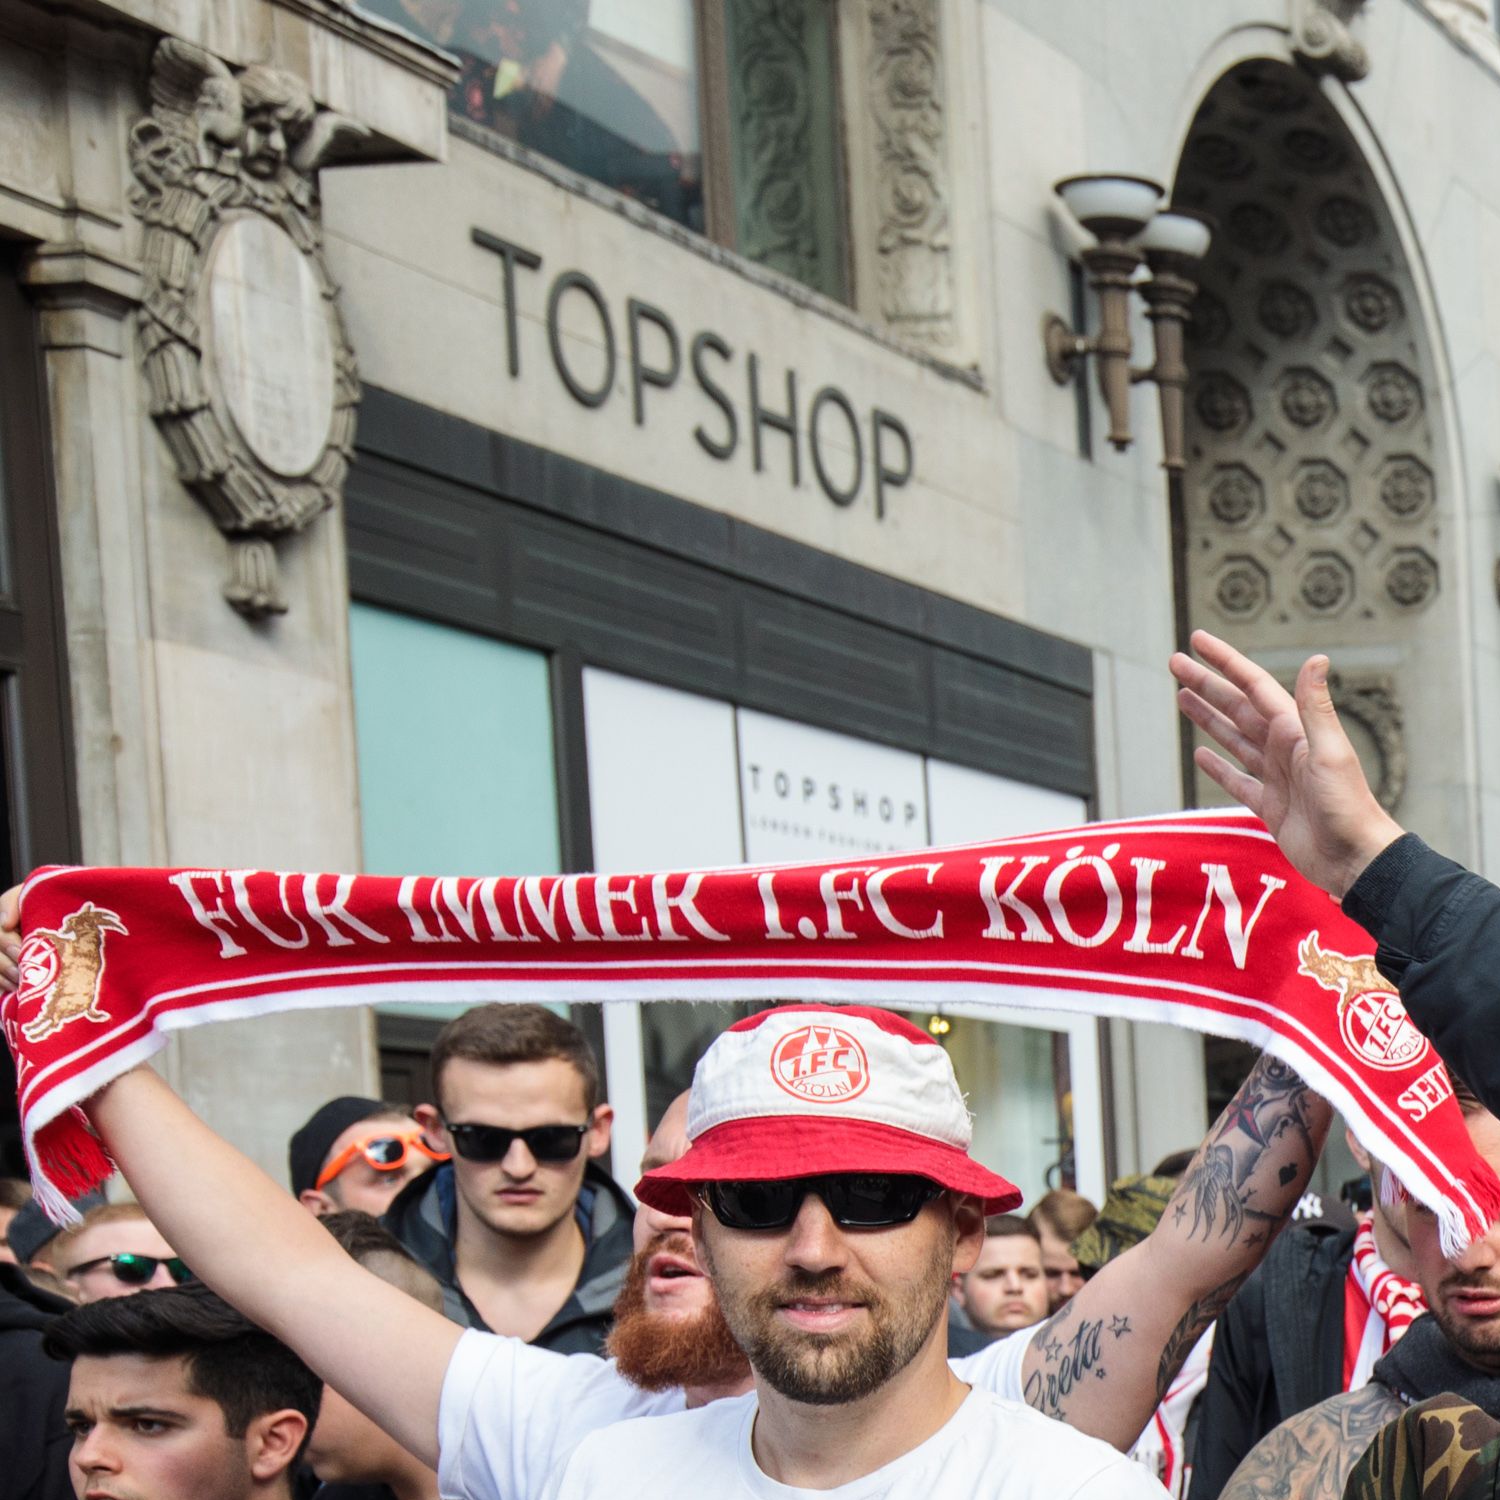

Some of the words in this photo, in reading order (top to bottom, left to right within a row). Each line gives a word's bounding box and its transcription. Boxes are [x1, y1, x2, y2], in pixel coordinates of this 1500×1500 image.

[471, 226, 913, 521] TOPSHOP
[749, 763, 916, 825] TOPSHOP
[398, 872, 730, 943] IMMER
[752, 863, 945, 940] 1.FC
[980, 843, 1285, 971] KÖLN
[790, 1048, 850, 1078] 1.FC
